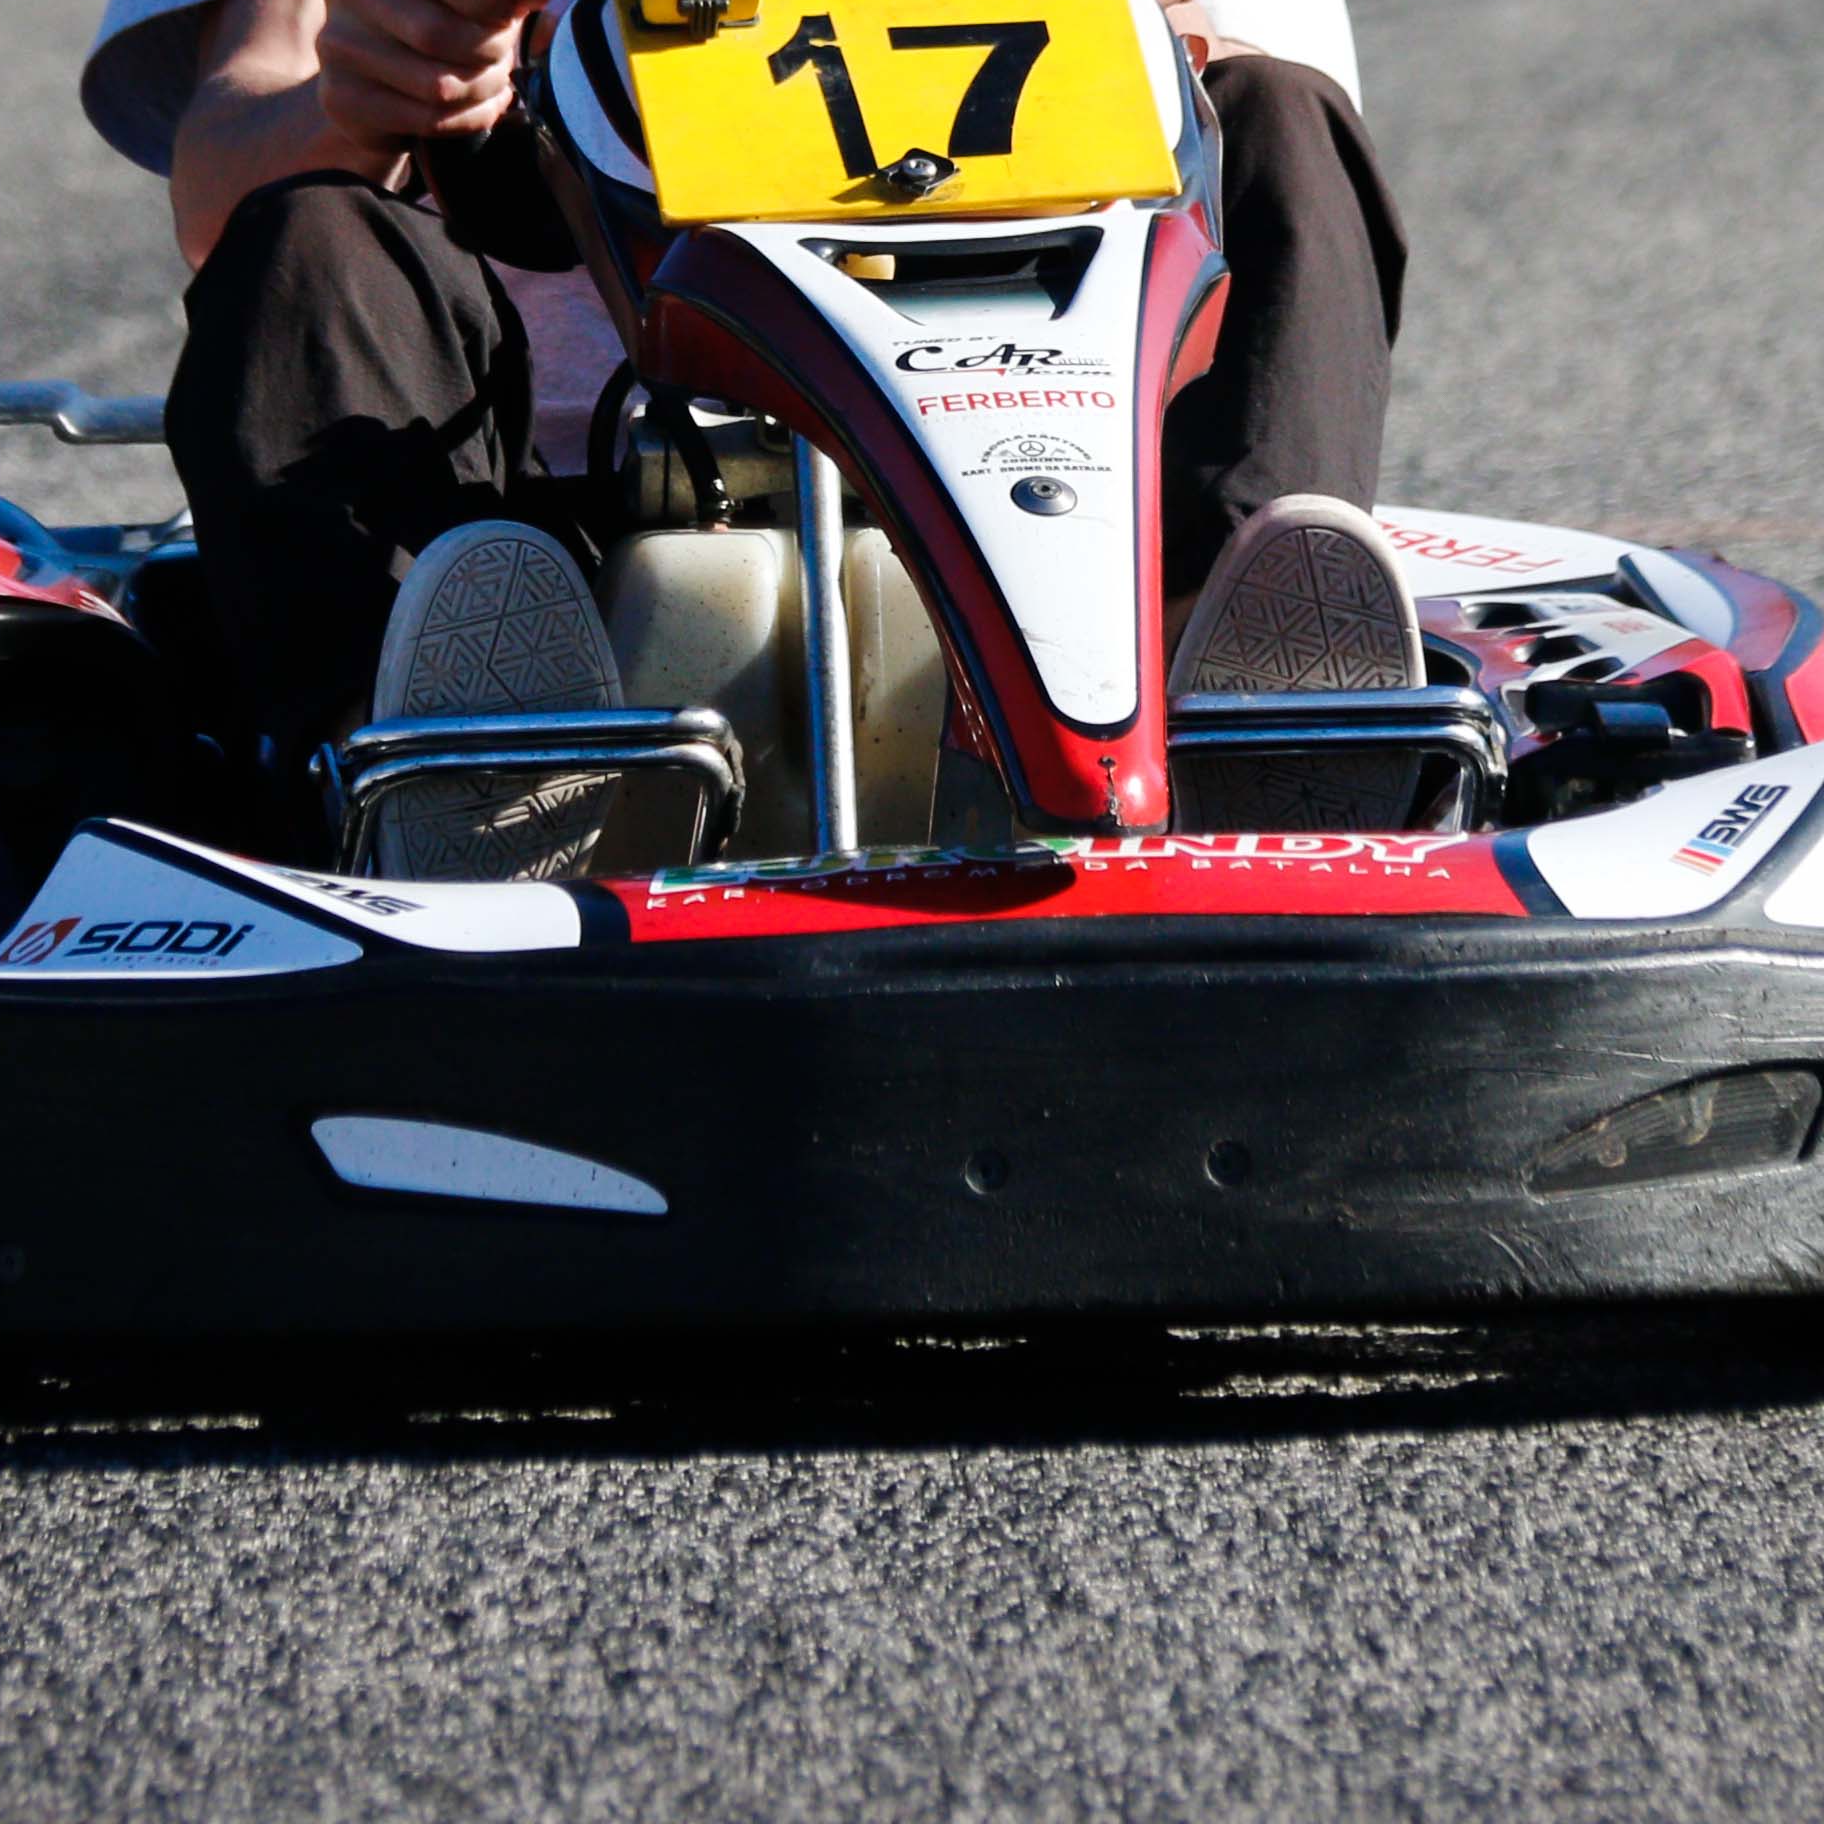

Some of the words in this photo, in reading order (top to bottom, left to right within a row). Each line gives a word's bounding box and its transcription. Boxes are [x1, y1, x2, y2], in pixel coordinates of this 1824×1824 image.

[767, 12, 1050, 180] 17
[916, 389, 1117, 417] FERBERTO
[1696, 782, 1792, 848] SWS
[1083, 859, 1151, 873] DA
[1191, 860, 1452, 880] BATALHA
[63, 920, 256, 957] SODI
